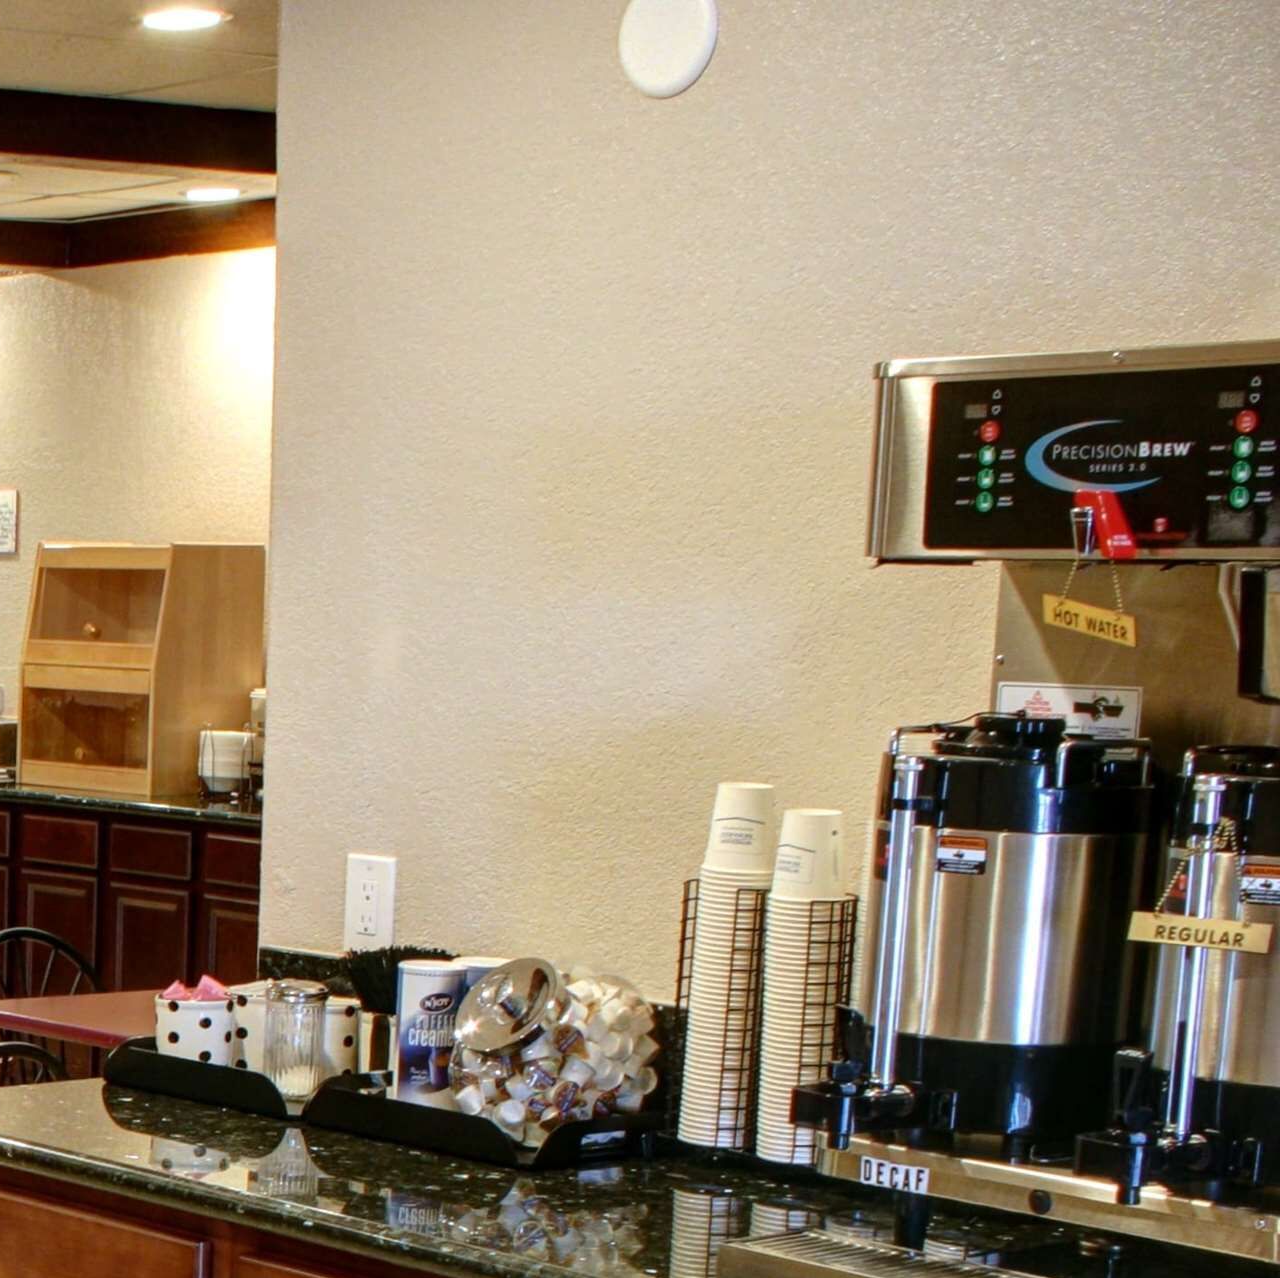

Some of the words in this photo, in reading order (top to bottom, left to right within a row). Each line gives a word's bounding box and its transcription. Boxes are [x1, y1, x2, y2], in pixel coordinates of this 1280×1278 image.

[1089, 463, 1124, 473] SERIES
[1053, 607, 1079, 628] HOT
[1085, 616, 1129, 640] WATER
[1154, 925, 1245, 947] REGULAR
[863, 1159, 926, 1191] DECAF
